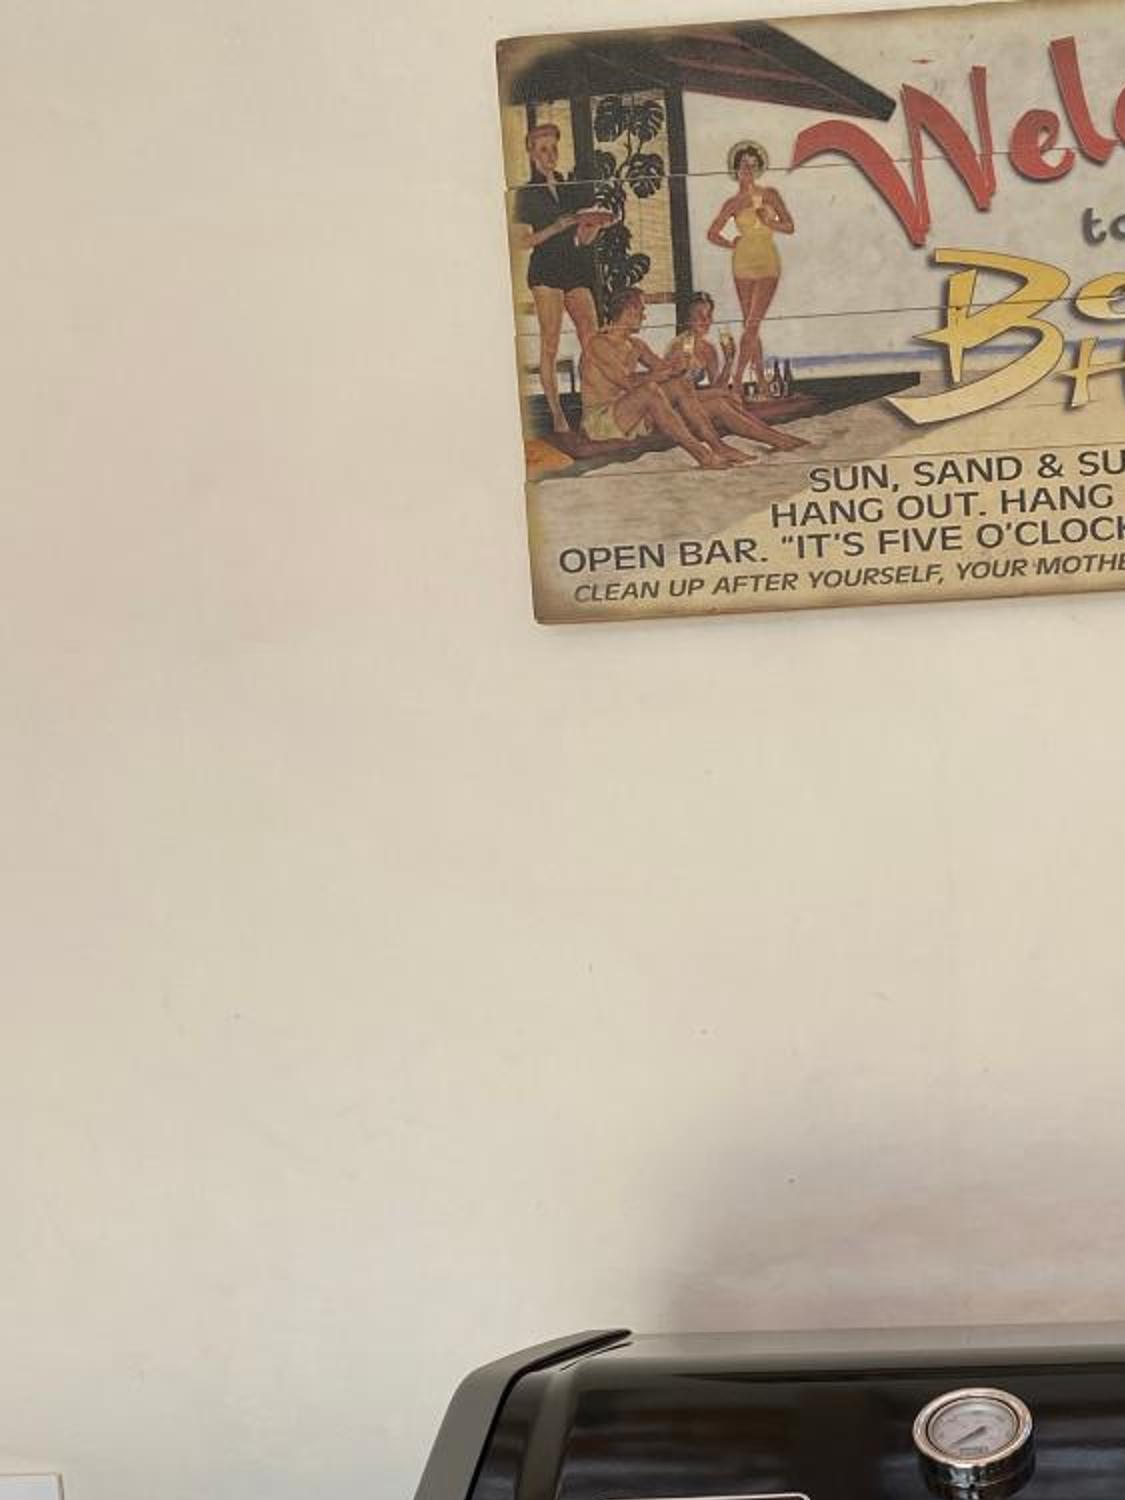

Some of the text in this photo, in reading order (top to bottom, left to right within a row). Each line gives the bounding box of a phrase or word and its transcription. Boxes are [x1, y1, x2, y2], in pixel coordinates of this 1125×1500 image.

[809, 463, 899, 493] SUN,
[913, 456, 1022, 487] SAND
[1038, 453, 1064, 479] &
[771, 498, 883, 528] HANG
[897, 492, 987, 521] OUT.
[1001, 484, 1113, 514] HANG
[559, 544, 665, 575] OPEN
[679, 538, 768, 567] BAR.
[879, 525, 962, 555] FIVE
[575, 580, 659, 603] CLEAN
[668, 578, 705, 597] UP
[713, 573, 798, 595] AFTER
[808, 565, 944, 589] YOURSELF,
[957, 559, 1028, 581] YOUR
